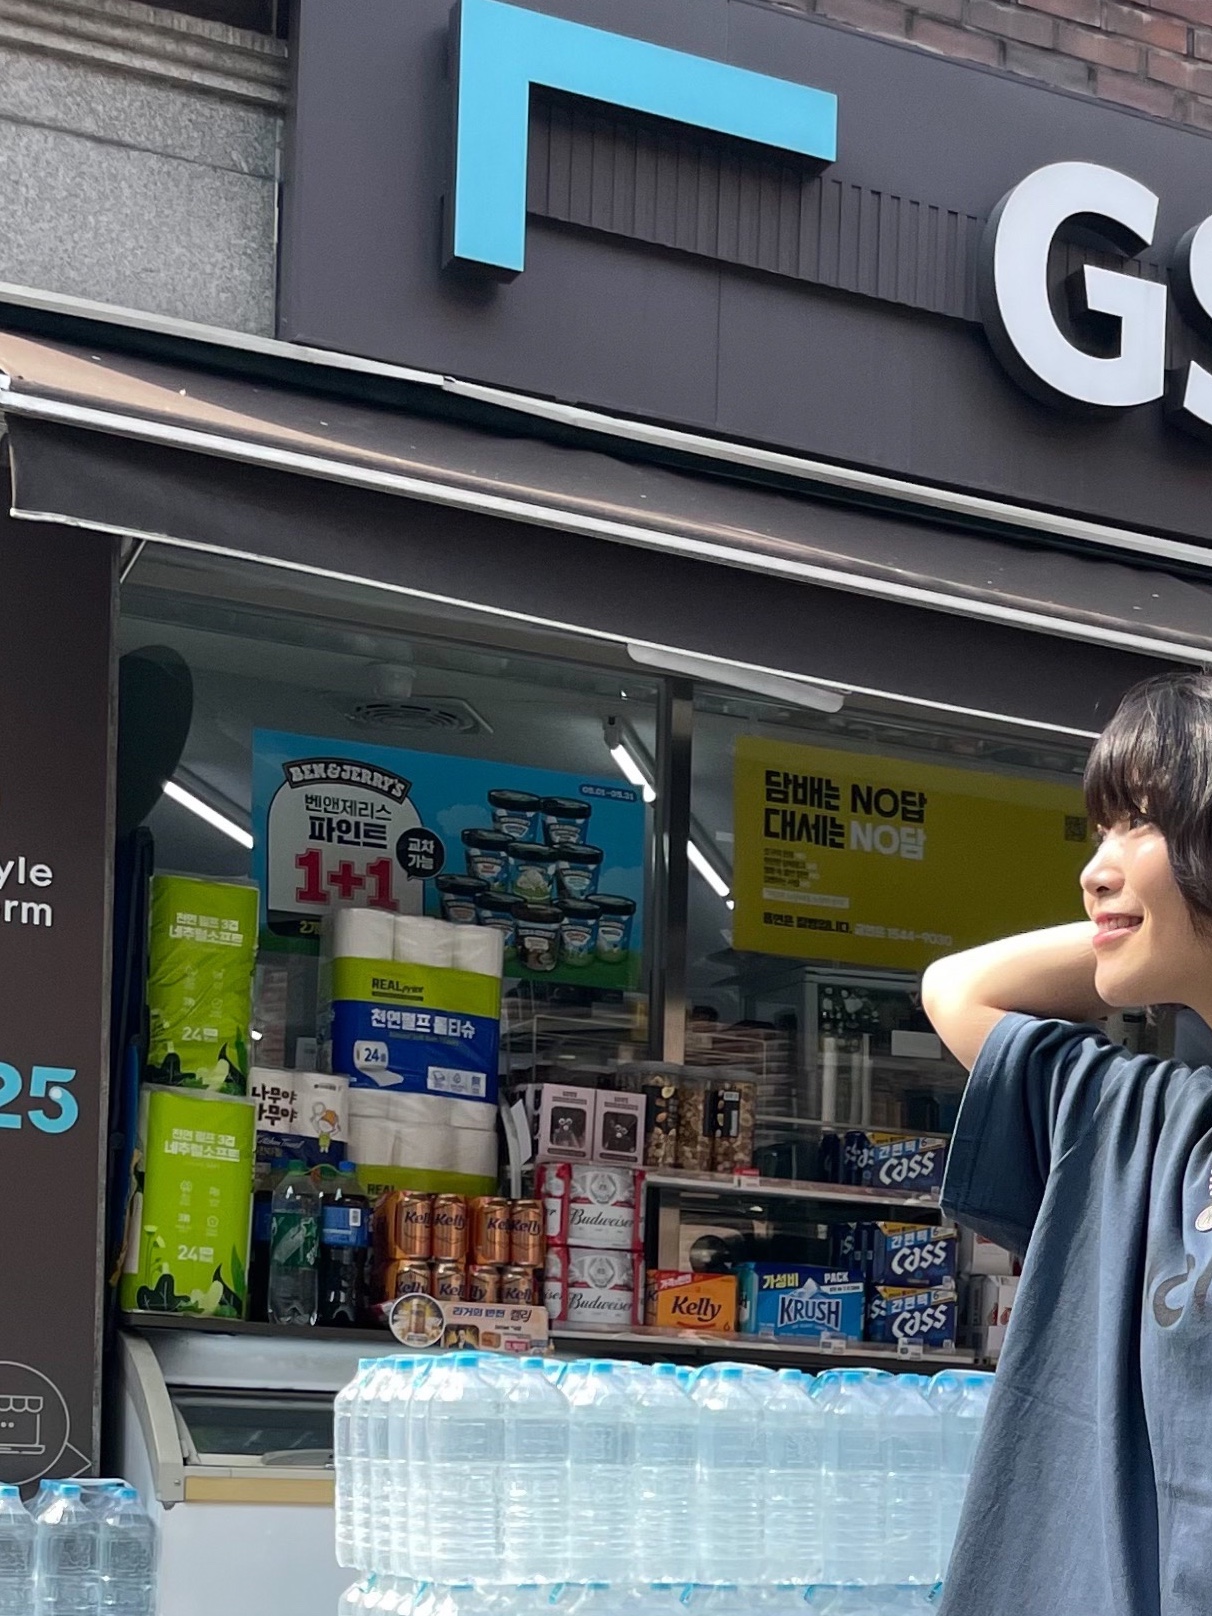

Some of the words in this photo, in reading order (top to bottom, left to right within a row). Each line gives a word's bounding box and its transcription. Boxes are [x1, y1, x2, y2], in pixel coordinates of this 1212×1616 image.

[765, 769, 840, 812] 담배는
[304, 793, 393, 822] 벤앤제리스
[308, 815, 388, 850] 파인트
[407, 837, 435, 855] 교차
[764, 807, 845, 849] 대세는
[851, 820, 927, 861] NO담
[407, 853, 434, 871] 가능
[295, 847, 400, 912] 1+1
[762, 1272, 800, 1289] 가성비
[823, 1271, 850, 1285] PACK
[671, 1295, 722, 1322] Kelly
[779, 1296, 841, 1331] KRUSH
